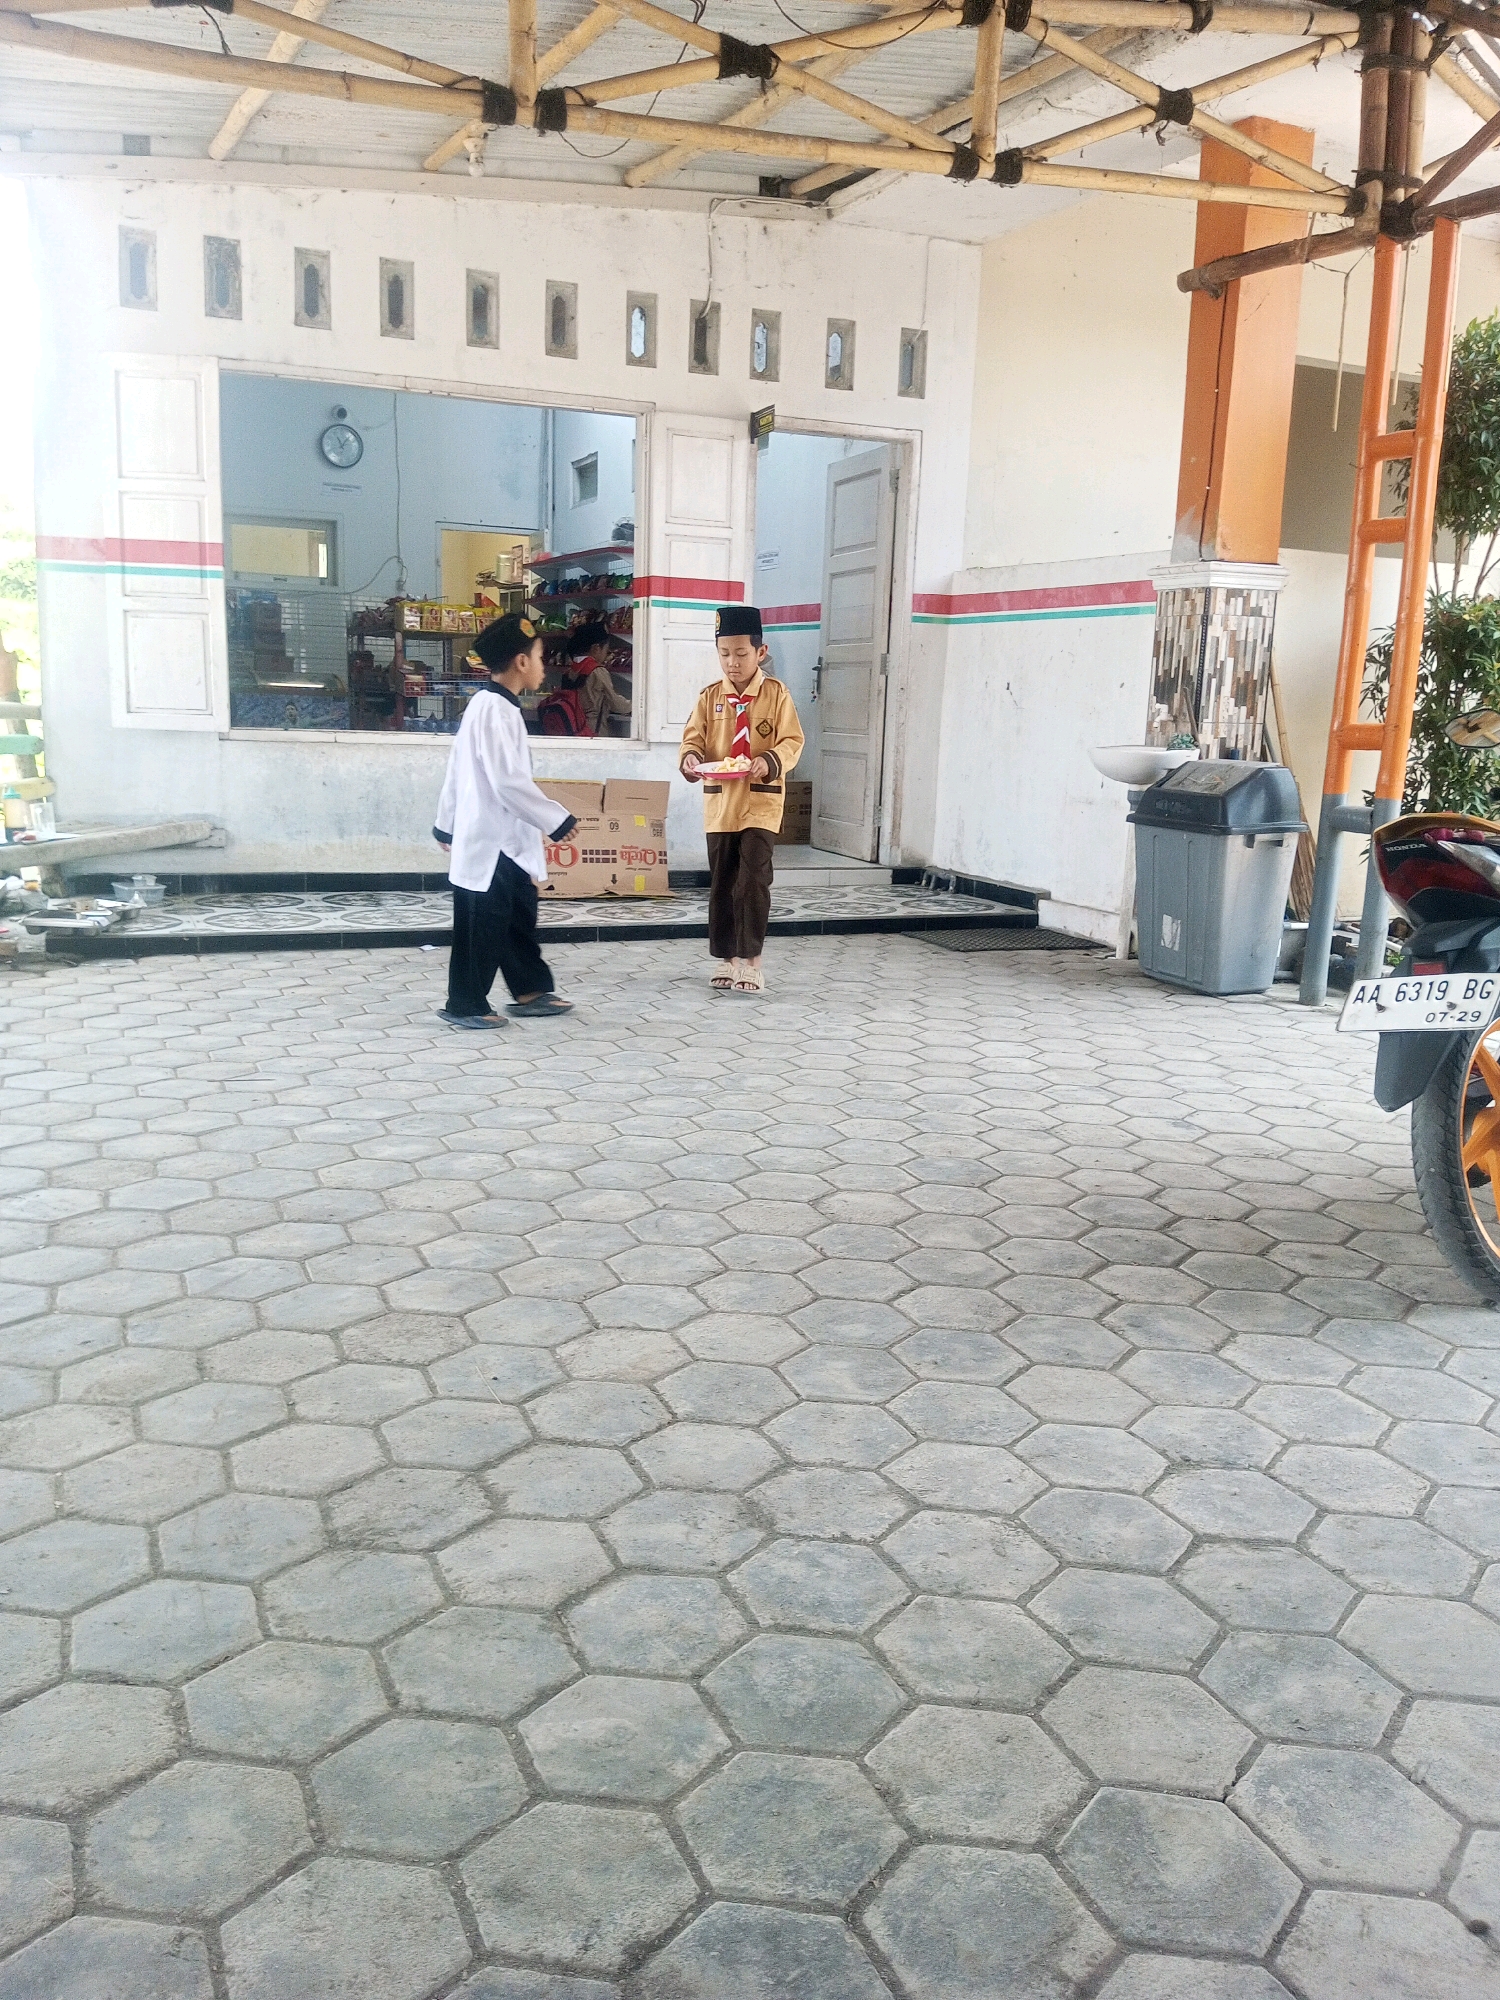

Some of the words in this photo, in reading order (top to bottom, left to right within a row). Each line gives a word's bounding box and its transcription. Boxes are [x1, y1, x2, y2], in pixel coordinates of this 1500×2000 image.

[1385, 843, 1428, 852] HONDA
[620, 849, 657, 866] Qtela
[1352, 984, 1381, 1004] AA
[1394, 980, 1449, 1003] 6319
[1462, 978, 1495, 1000] BG
[1425, 1010, 1482, 1023] 07-29
